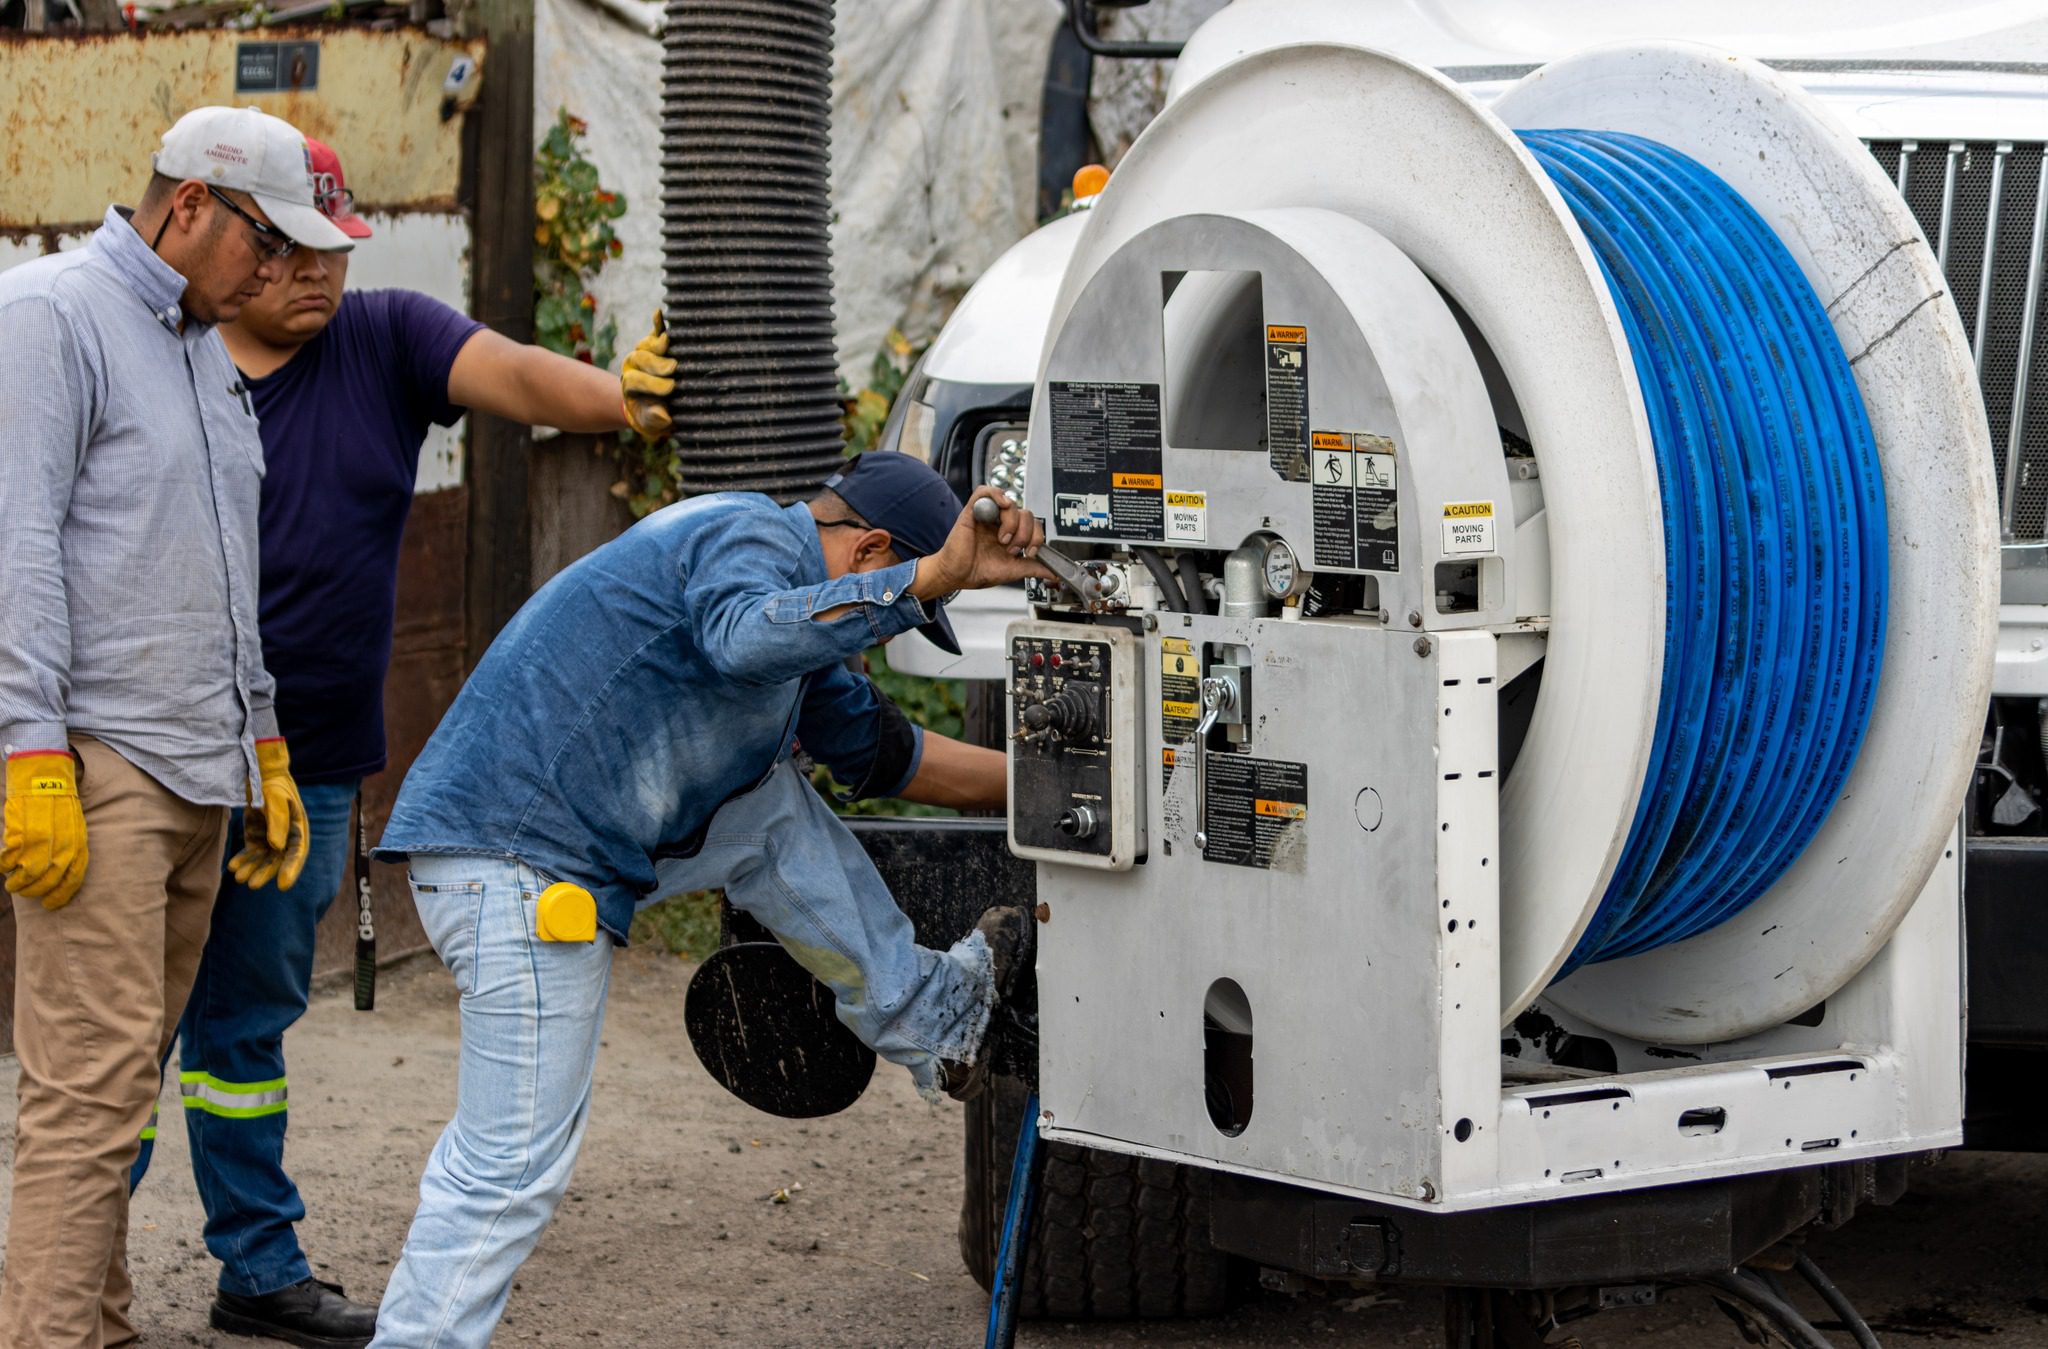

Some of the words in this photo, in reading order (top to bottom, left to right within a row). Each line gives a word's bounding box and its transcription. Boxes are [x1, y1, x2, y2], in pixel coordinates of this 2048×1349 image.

[215, 143, 243, 154] MEDIO
[204, 149, 248, 164] AMBIENTE
[1276, 330, 1304, 339] WARNING
[1128, 478, 1154, 487] WARNING
[1174, 495, 1204, 505] CAUTION
[1452, 504, 1491, 515] CAUTION
[1174, 513, 1198, 522] MOVING
[1176, 523, 1197, 532] PARTS
[1452, 524, 1484, 534] MOVING
[1455, 534, 1482, 544] PARTS
[1842, 527, 1850, 569] PRODUCTS
[1841, 607, 1850, 633] SEWER
[1836, 635, 1848, 676] CLEANING
[358, 877, 374, 941] Jeep
